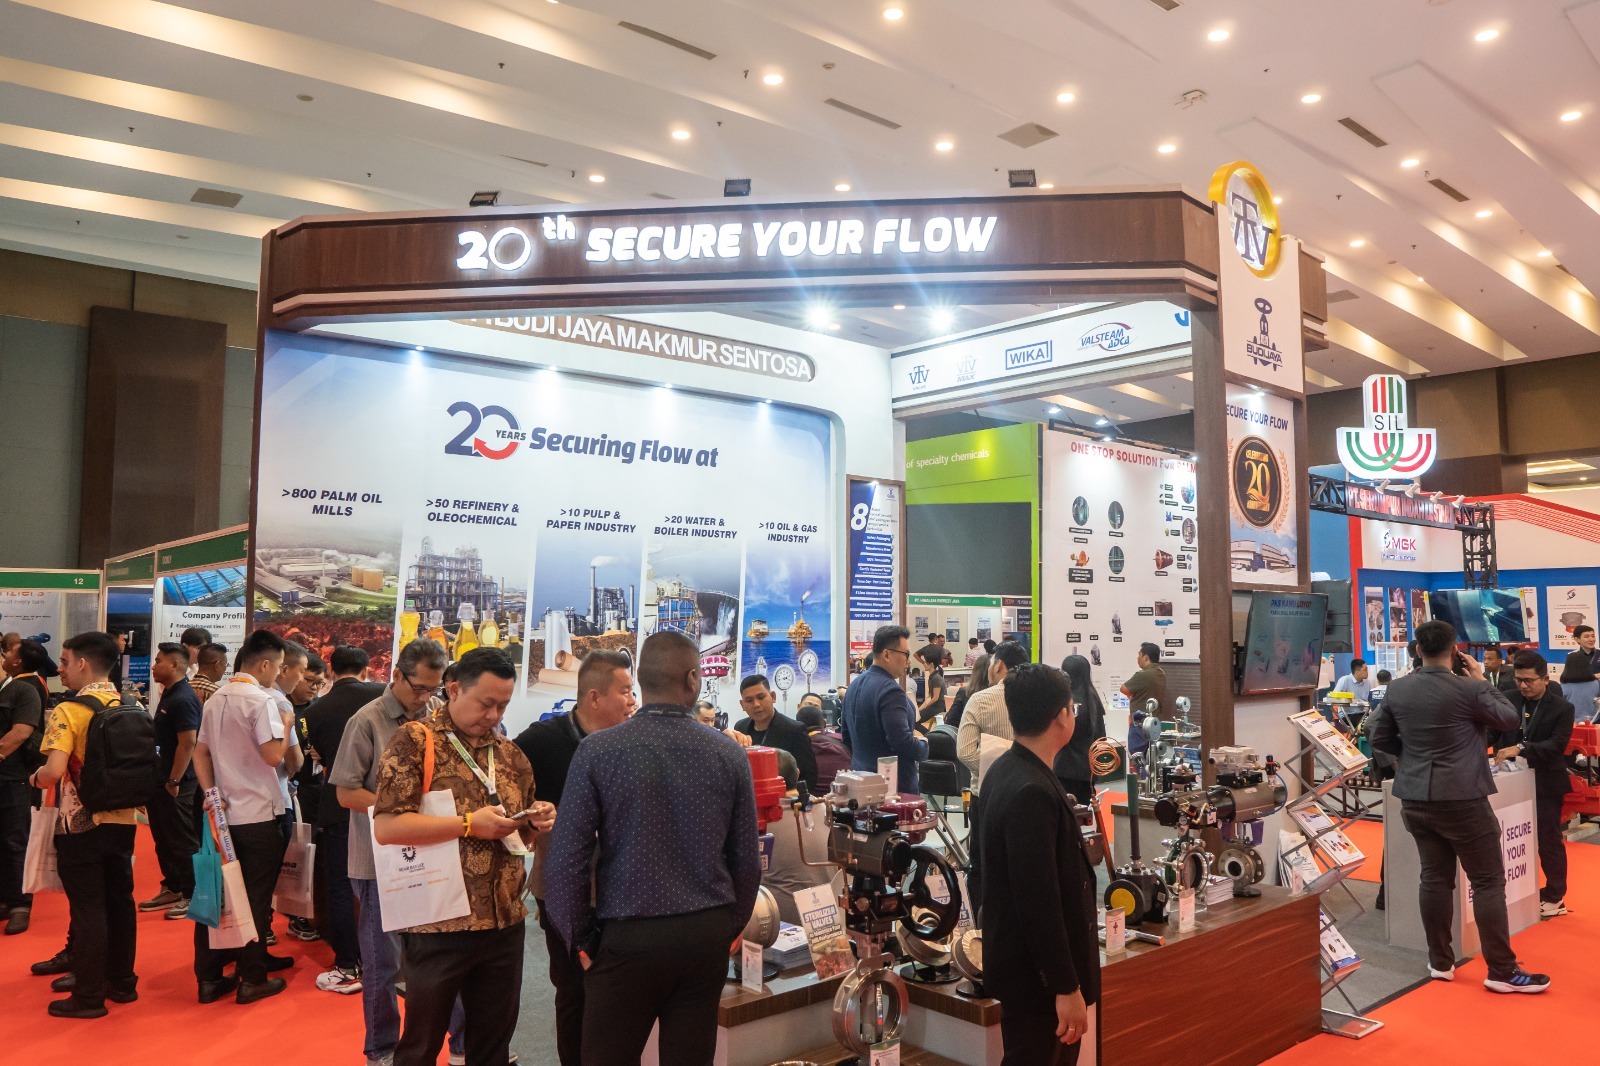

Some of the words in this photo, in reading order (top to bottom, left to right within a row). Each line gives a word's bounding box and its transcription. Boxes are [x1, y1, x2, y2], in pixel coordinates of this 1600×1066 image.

[457, 227, 531, 271] 20
[543, 215, 576, 240] th
[585, 223, 742, 262] SECURE
[753, 219, 864, 257] YOUR
[873, 216, 997, 255] FLOW
[1081, 328, 1124, 346] VALSTEAM
[558, 315, 615, 346] JAYA
[617, 324, 718, 363] MAKMUR
[719, 342, 811, 379] SENTOSA
[1246, 343, 1282, 363] BUDIJAYA
[1010, 348, 1045, 365] WIKA
[1226, 404, 1248, 420] ECURE
[1250, 410, 1269, 426] YOUR
[1269, 416, 1289, 431] FLOW
[1374, 414, 1403, 431] SIL
[444, 401, 520, 460] 20
[495, 429, 526, 441] YEARS
[529, 426, 636, 464] Securing
[639, 439, 692, 465] Flow
[695, 447, 718, 467] at
[916, 454, 949, 468] specialty
[951, 449, 990, 462] chemicals
[1070, 441, 1089, 455] ONE
[1091, 445, 1114, 459] STOP
[1116, 450, 1158, 468] SOLUTION
[1159, 461, 1175, 470] FOR
[1244, 460, 1271, 501] 20
[281, 488, 317, 500] >800
[320, 490, 358, 502] PALM
[361, 493, 383, 504] OIL
[312, 504, 353, 517] MILLS
[426, 499, 450, 509] >50
[452, 499, 509, 512] REFINERY
[511, 503, 520, 513] &
[560, 508, 580, 518] >10
[583, 509, 610, 520] PULP
[613, 511, 621, 520] &
[427, 512, 518, 527] OLEOCHEMICAL
[664, 515, 683, 525] >20
[684, 516, 715, 527] WATER
[718, 518, 726, 527] &
[850, 502, 869, 531] 8
[546, 519, 581, 531] PAPER
[583, 522, 637, 534] INDUSTRY
[653, 526, 689, 537] BOILER
[691, 528, 738, 540] INDUSTRY
[758, 521, 775, 531] >10
[776, 522, 791, 532] OIL
[792, 523, 799, 532] &
[801, 524, 818, 533] GAS
[767, 533, 810, 544] INDUSTRY
[1391, 537, 1416, 550] MGK
[182, 611, 221, 621] Company
[1506, 822, 1531, 841] SECURE
[1506, 843, 1526, 861] YOUR
[1507, 863, 1527, 882] FLOW
[811, 916, 834, 929] VALVES
